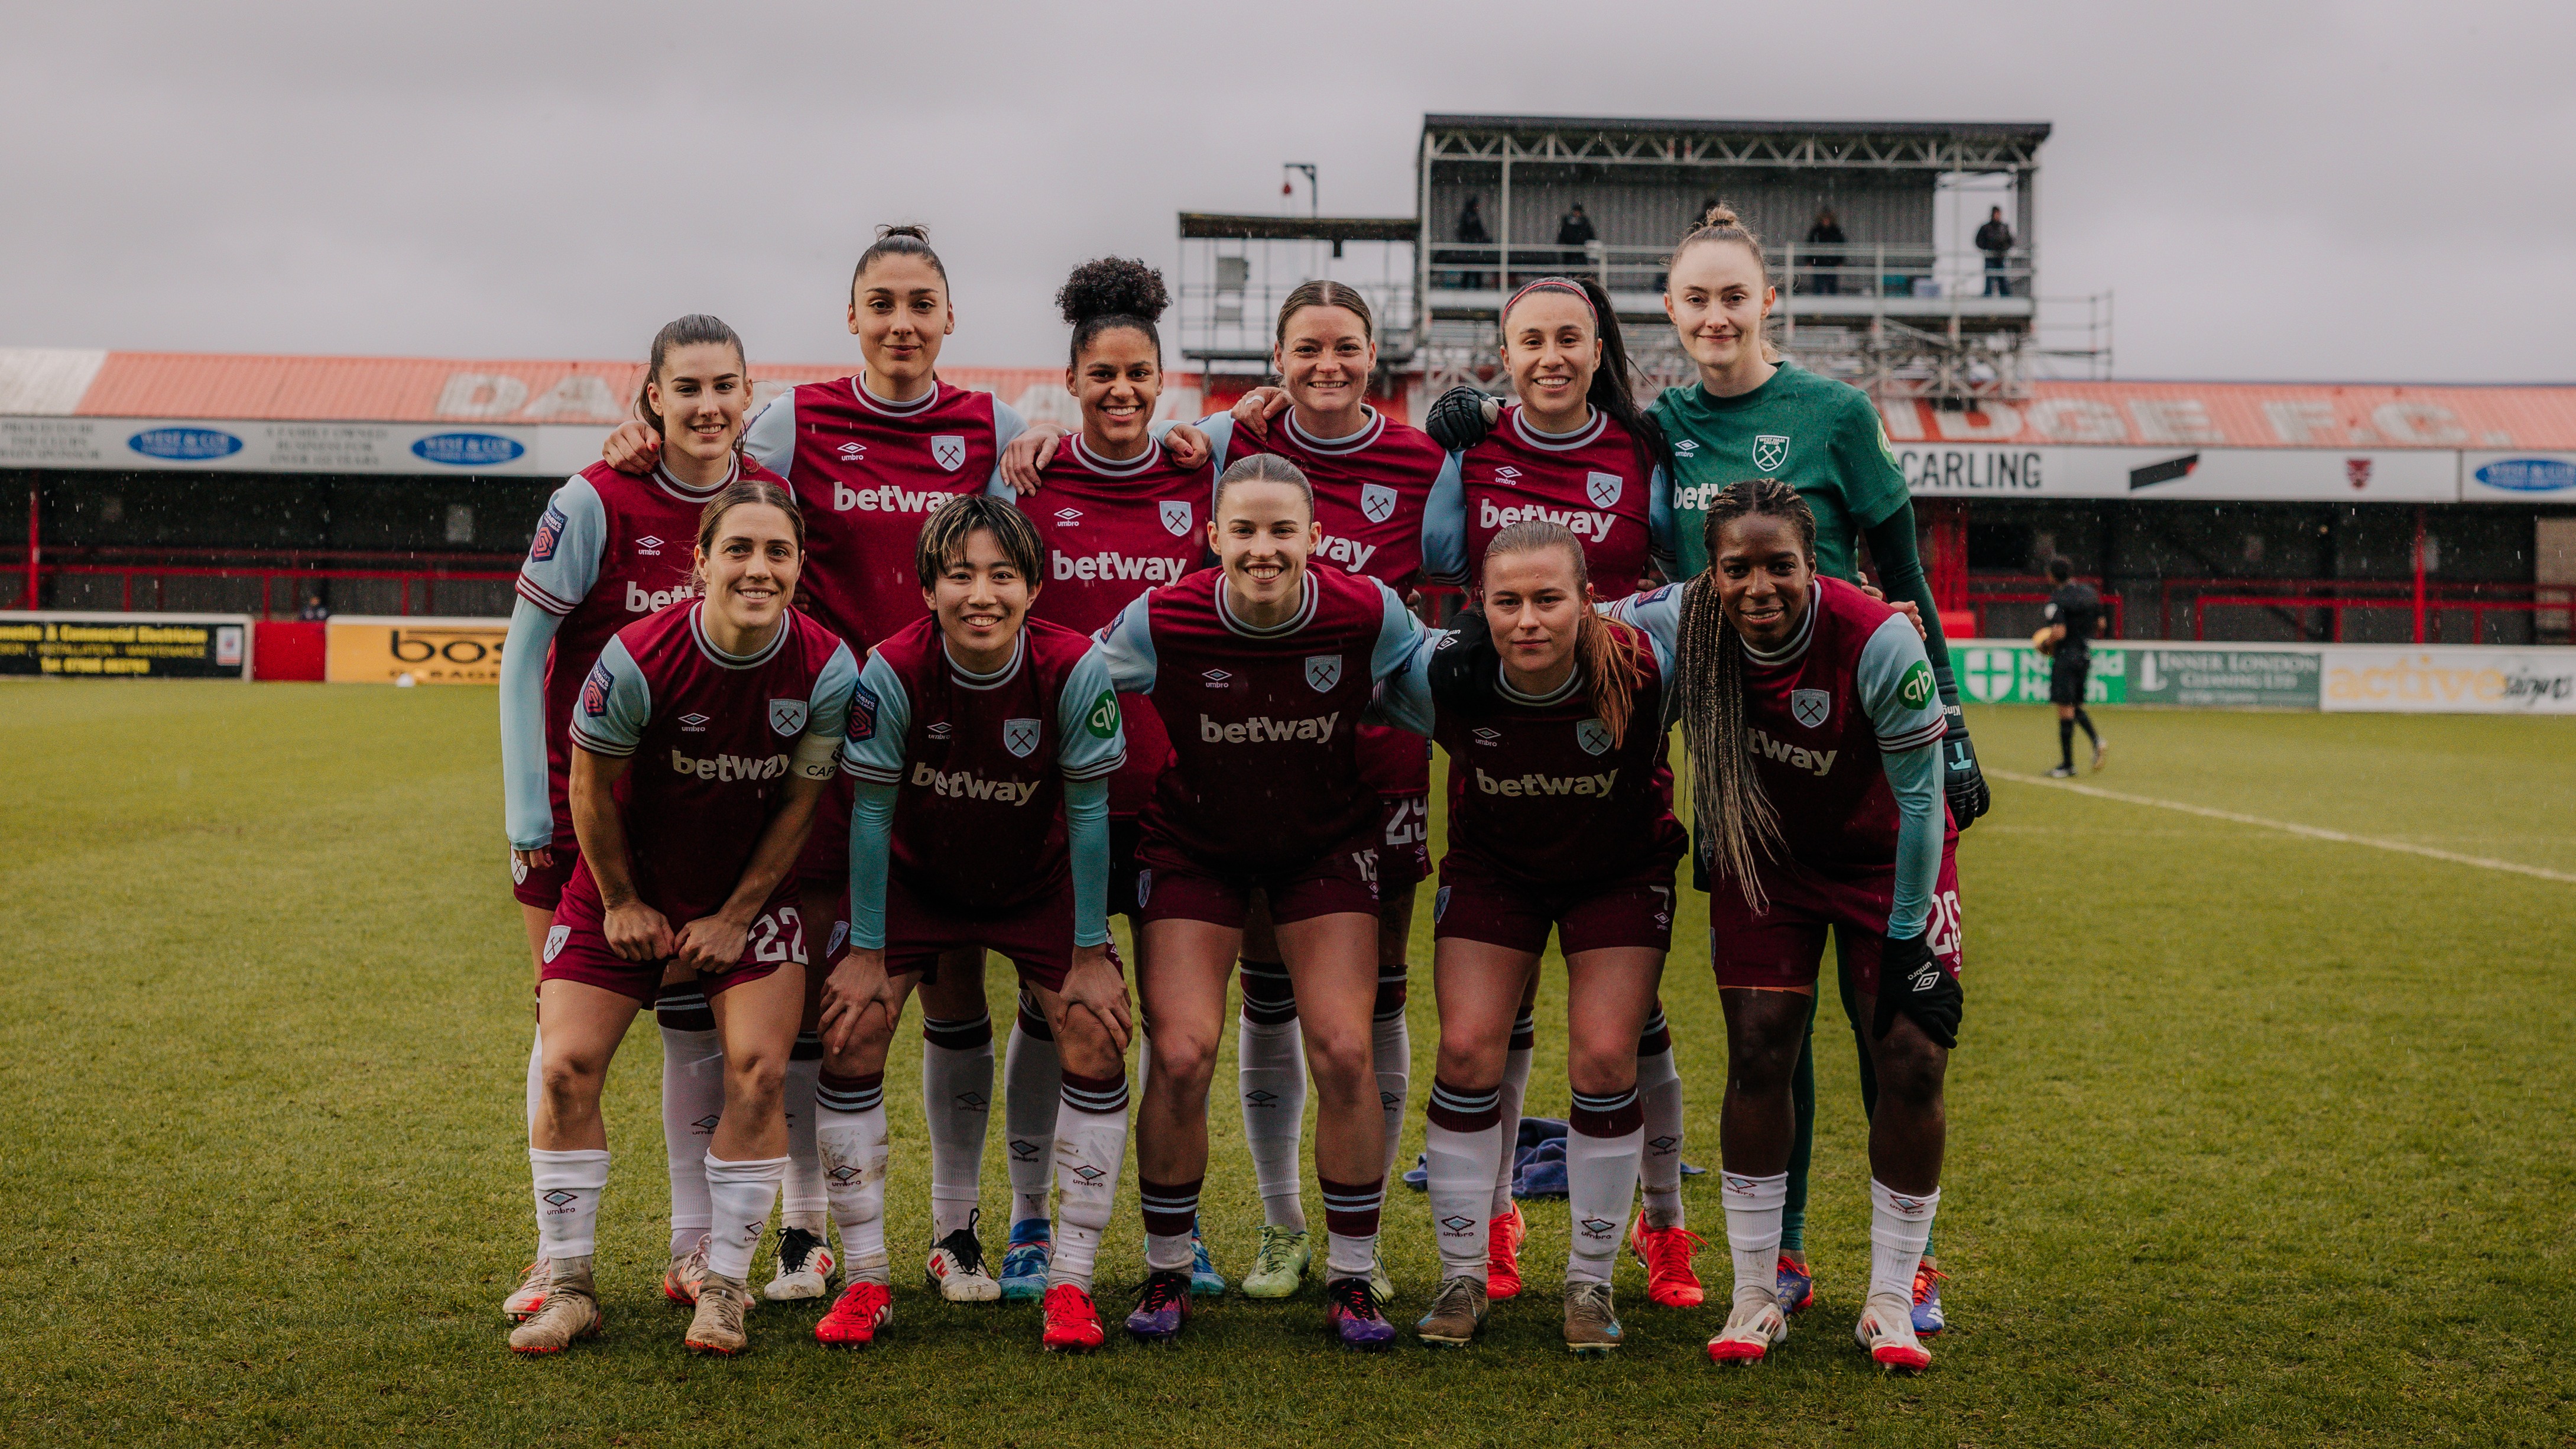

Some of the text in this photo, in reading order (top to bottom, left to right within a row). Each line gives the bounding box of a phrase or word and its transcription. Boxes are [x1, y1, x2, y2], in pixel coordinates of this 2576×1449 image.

[1495, 477, 1516, 485] umbro
[1901, 451, 2042, 489] CARLING
[1673, 479, 1720, 510] bet
[1481, 498, 1617, 543] betway
[1053, 550, 1186, 586] betway
[1316, 534, 1376, 573] way
[625, 581, 705, 612] bet
[2228, 651, 2318, 670] LONDON
[2328, 654, 2506, 701] active
[855, 690, 875, 708] OMEN'S
[1201, 712, 1339, 744] betway
[672, 750, 791, 782] betway
[1748, 728, 1837, 776] tway
[806, 765, 836, 777] CAP
[911, 763, 1040, 806] betway
[1476, 767, 1618, 798] betway
[748, 907, 809, 965] 22
[1907, 961, 1932, 981] umbro
[1581, 1231, 1611, 1240] umbro
